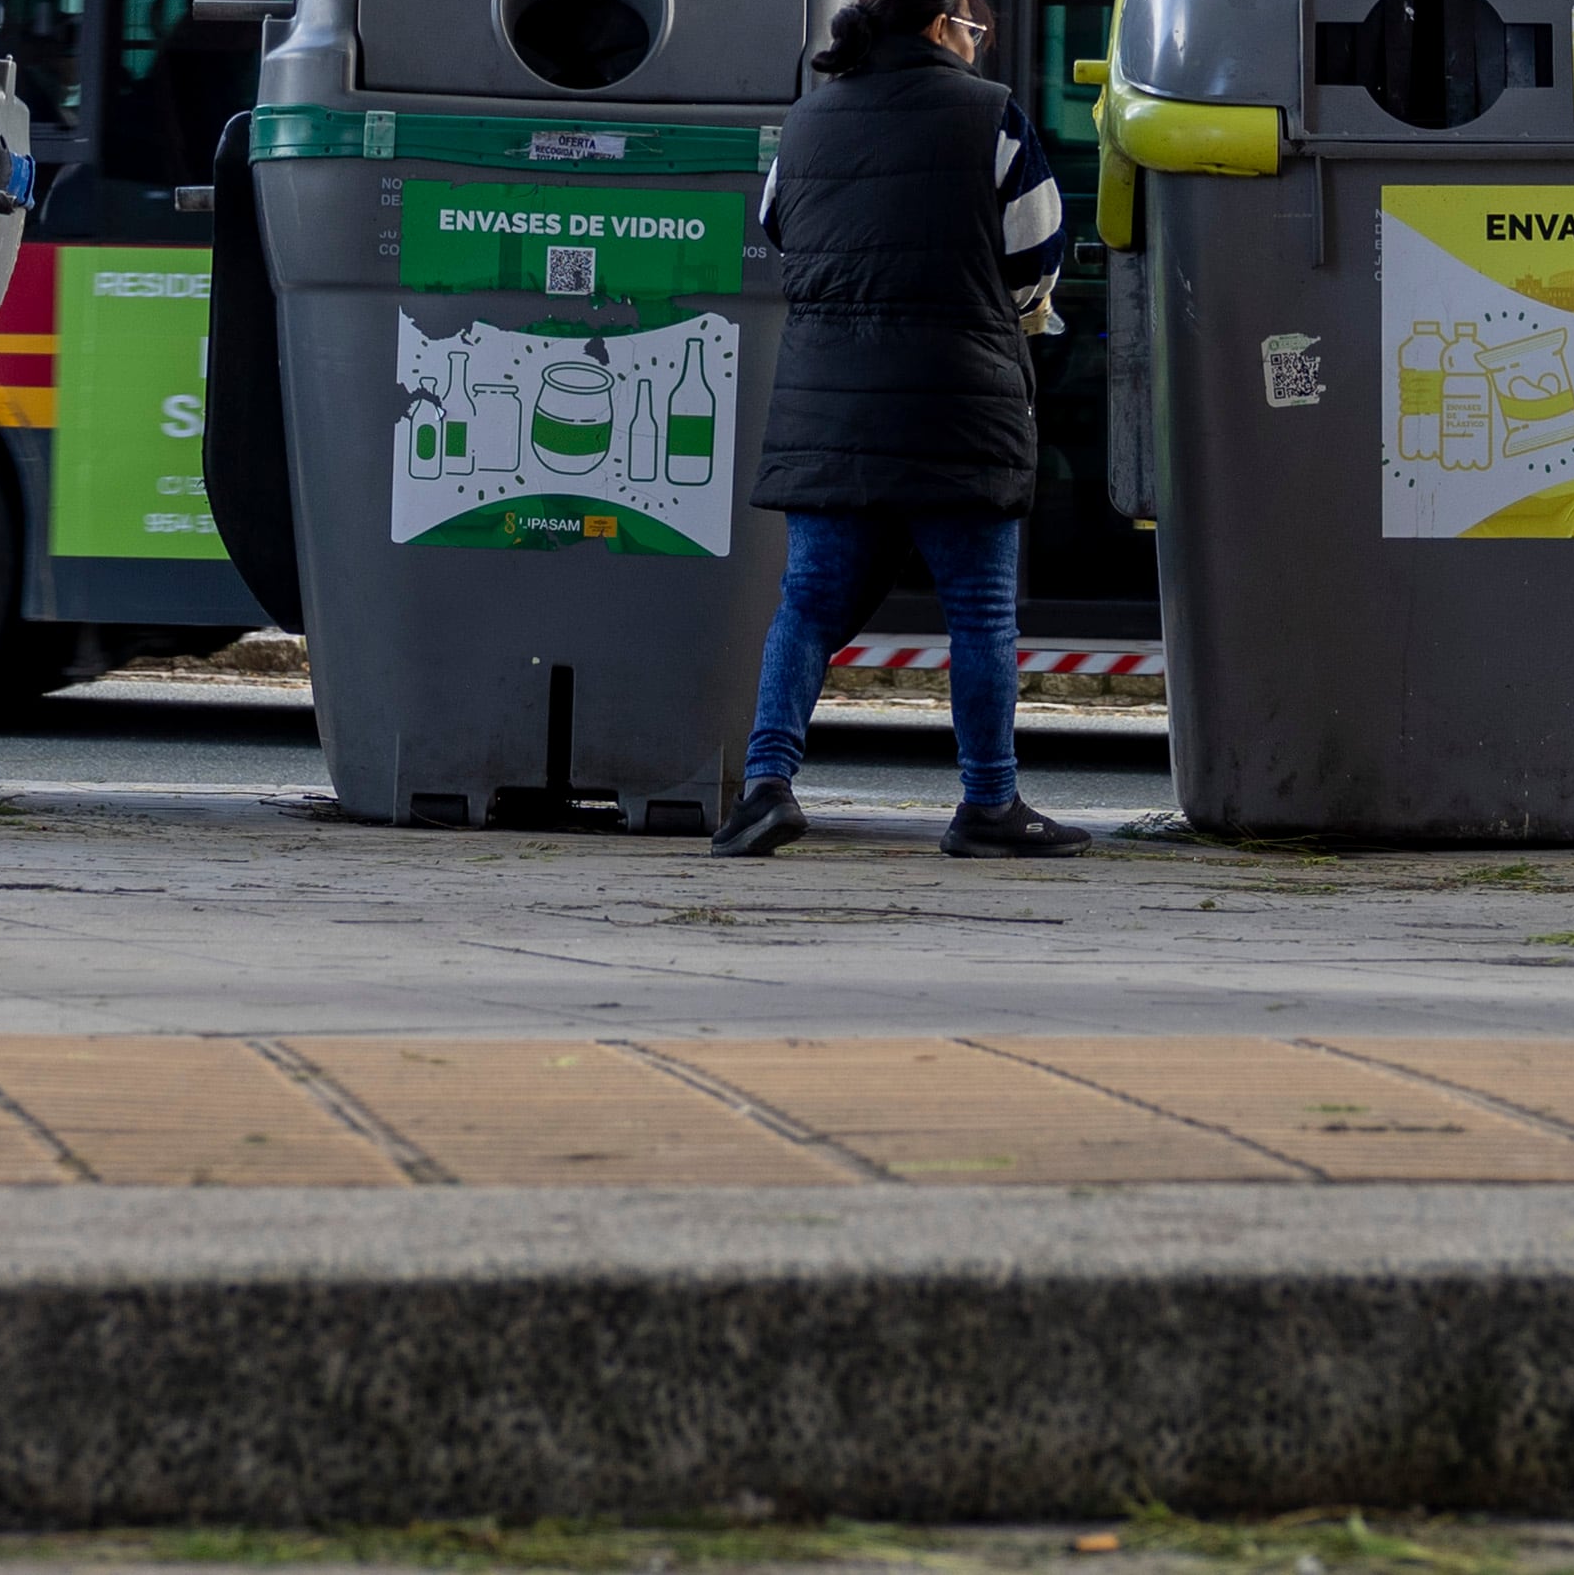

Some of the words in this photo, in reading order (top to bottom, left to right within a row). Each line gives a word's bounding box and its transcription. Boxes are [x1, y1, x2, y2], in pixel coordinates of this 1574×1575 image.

[558, 136, 596, 149] OFERTA
[381, 177, 403, 190] NO
[381, 194, 404, 206] DE
[439, 209, 561, 235] ENVASES
[569, 215, 605, 237] DE
[611, 216, 705, 240] VIDRIO
